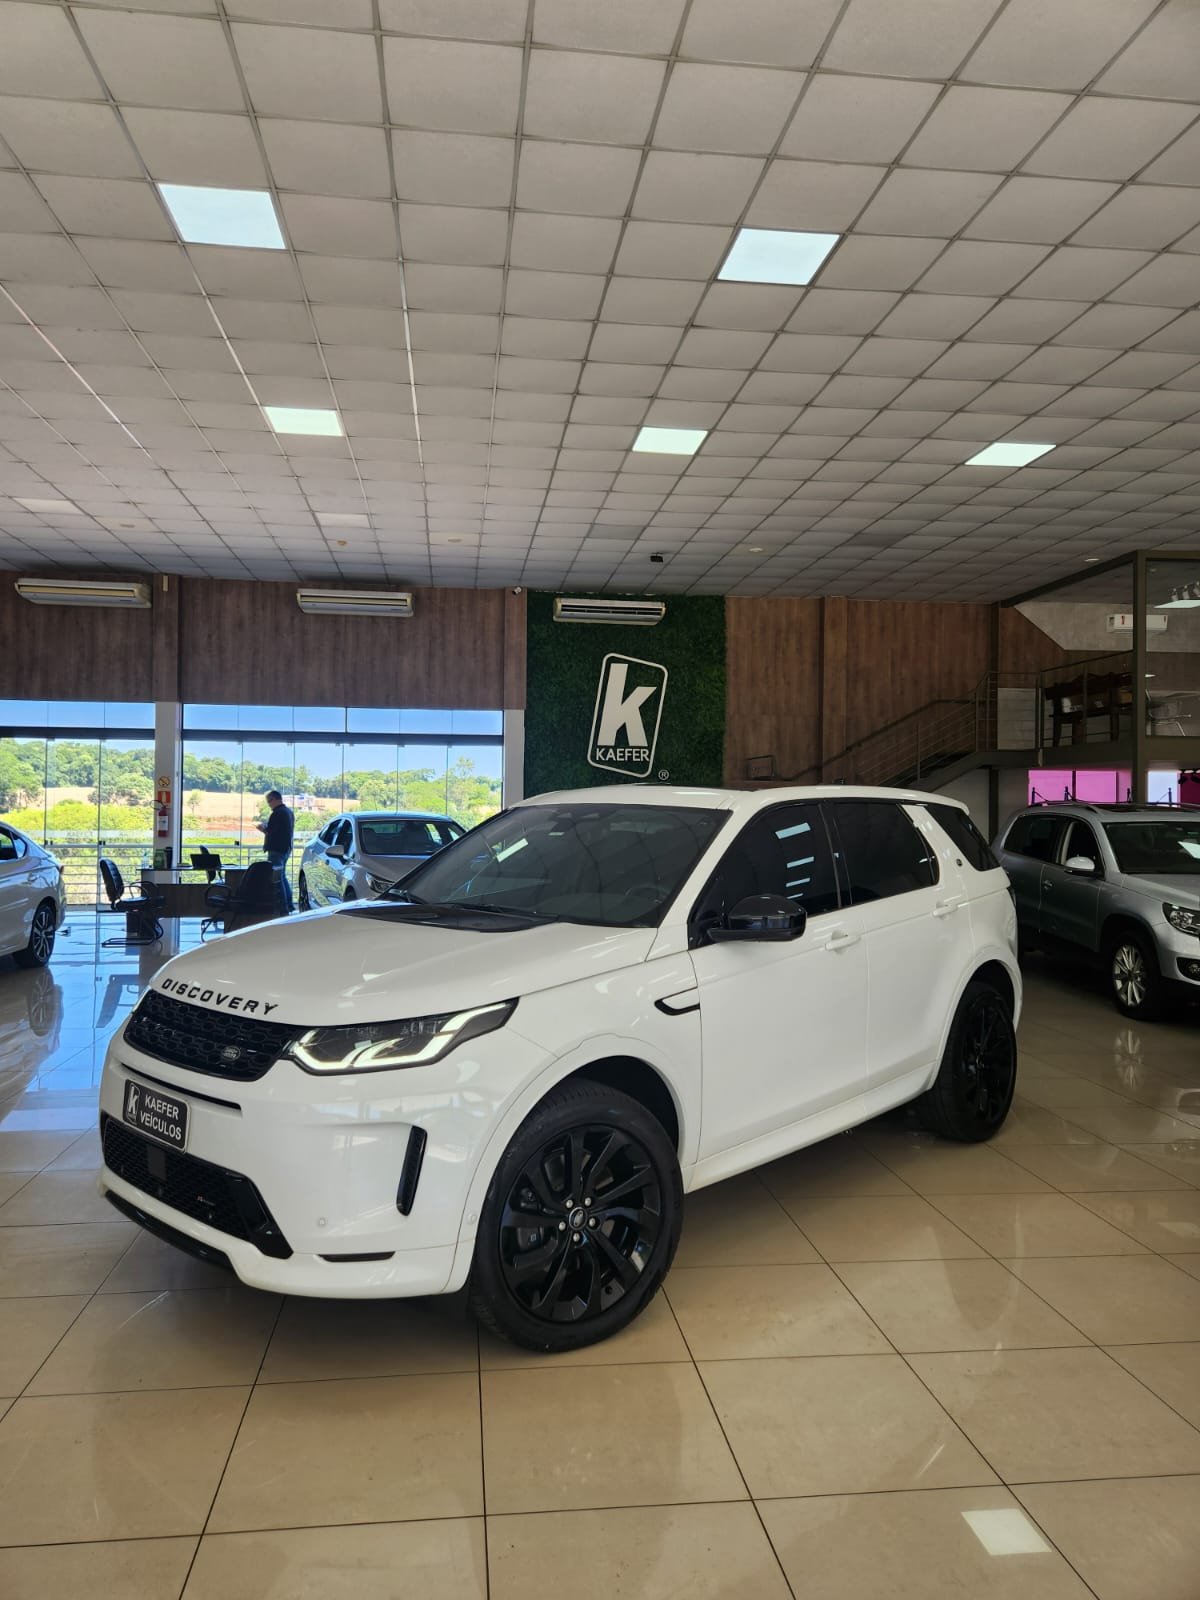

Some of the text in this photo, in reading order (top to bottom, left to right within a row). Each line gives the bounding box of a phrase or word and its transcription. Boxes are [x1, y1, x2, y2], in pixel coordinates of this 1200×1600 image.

[596, 748, 650, 762] KAEFER
[161, 978, 279, 1015] DISCOVERY
[145, 1094, 179, 1120] KAEFER
[140, 1110, 182, 1140] VEÍCULOS
